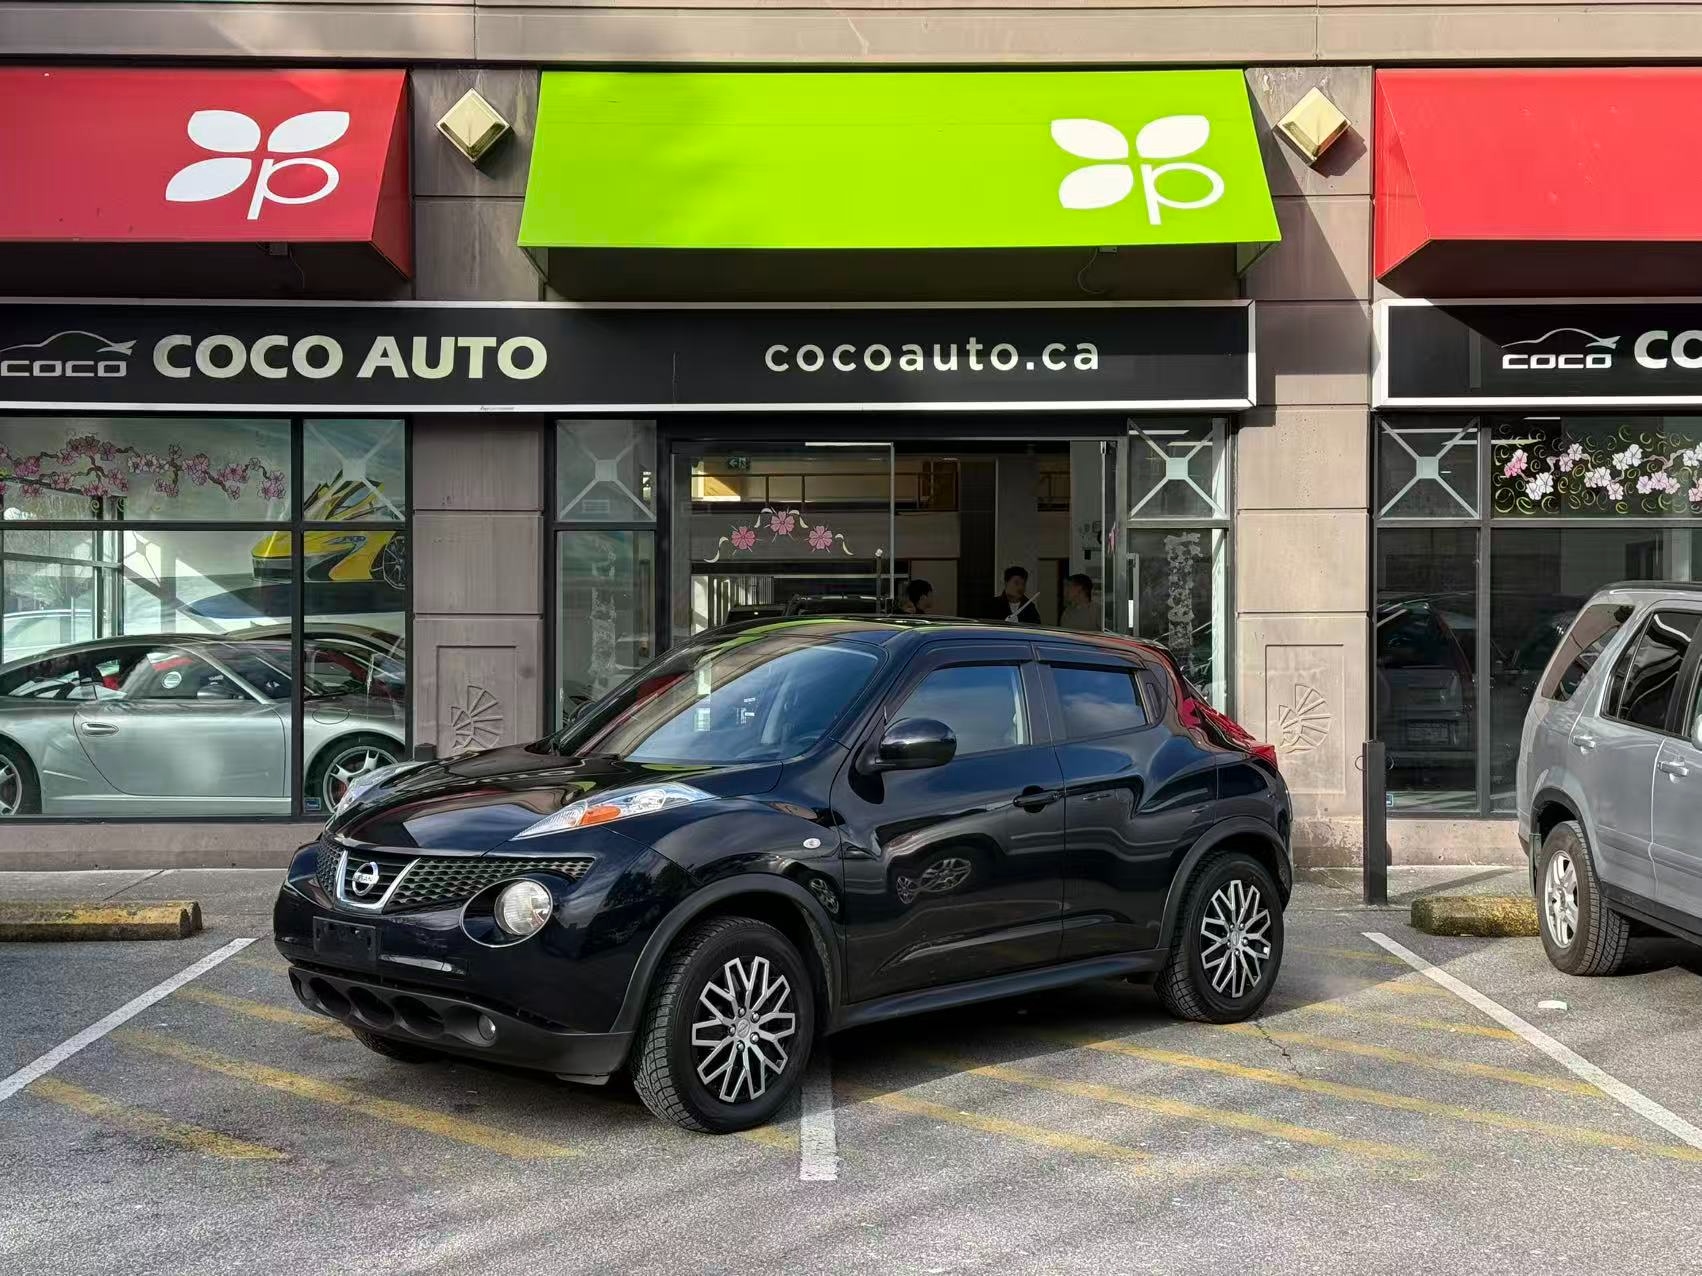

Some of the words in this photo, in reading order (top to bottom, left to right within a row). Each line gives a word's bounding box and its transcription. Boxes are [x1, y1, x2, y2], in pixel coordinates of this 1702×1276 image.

[153, 334, 344, 379] COCO
[356, 335, 548, 380] AUTO
[764, 337, 1100, 373] cocoauto.ca
[1502, 353, 1612, 369] COCO
[1633, 329, 1702, 369] CO
[0, 360, 127, 377] COCO
